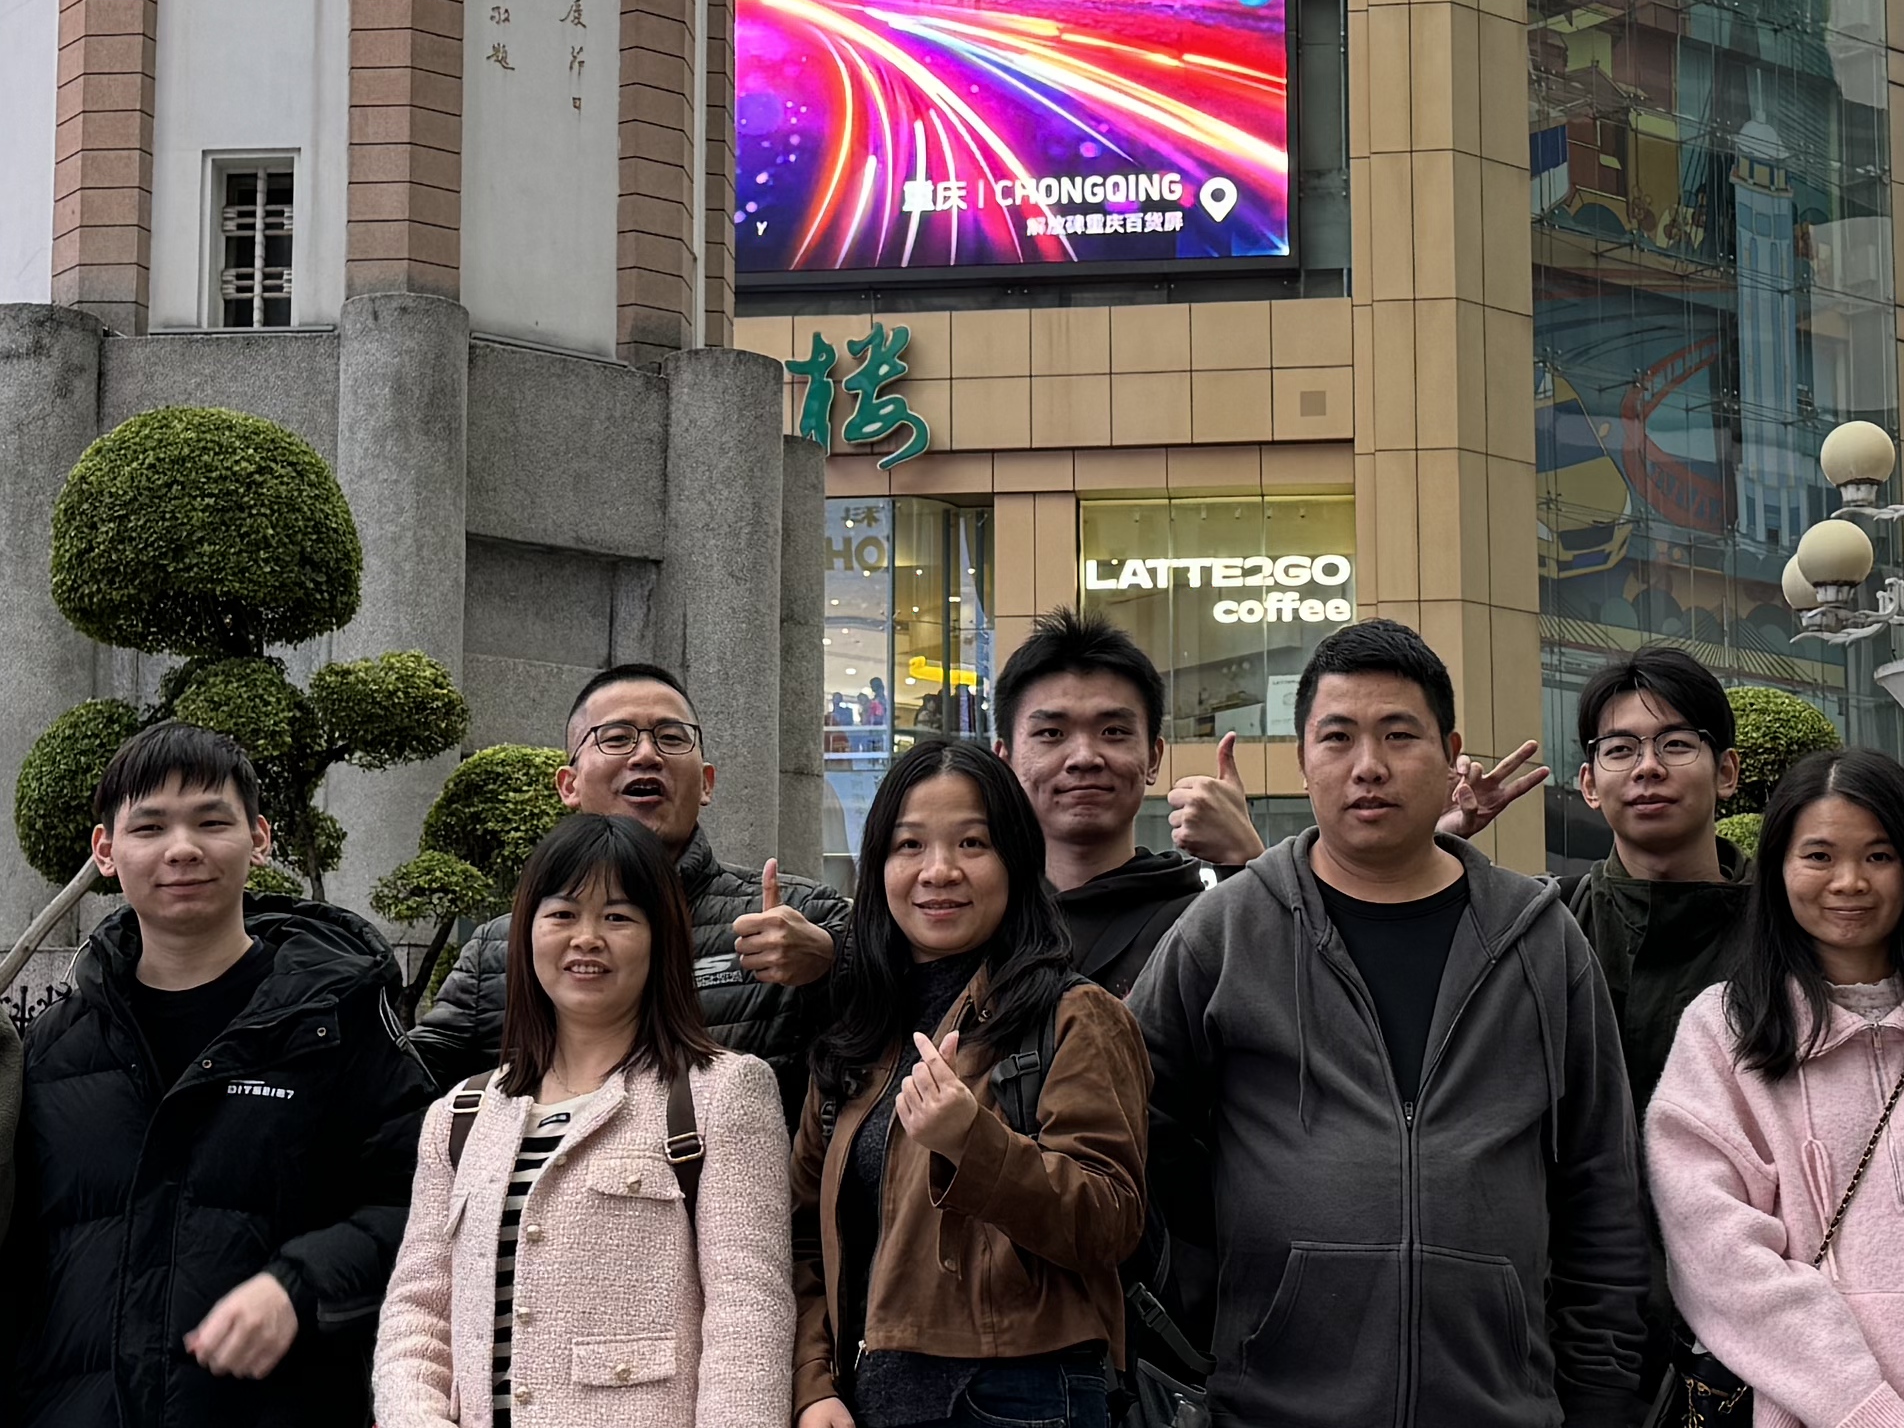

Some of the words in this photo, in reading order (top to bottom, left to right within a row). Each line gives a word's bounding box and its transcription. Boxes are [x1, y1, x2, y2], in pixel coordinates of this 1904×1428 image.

[902, 179, 968, 213] 重庆
[994, 172, 1183, 206] CHONGQING
[784, 321, 931, 471] 楼
[1084, 553, 1353, 592] LATTE2GO
[1212, 591, 1353, 624] coffee
